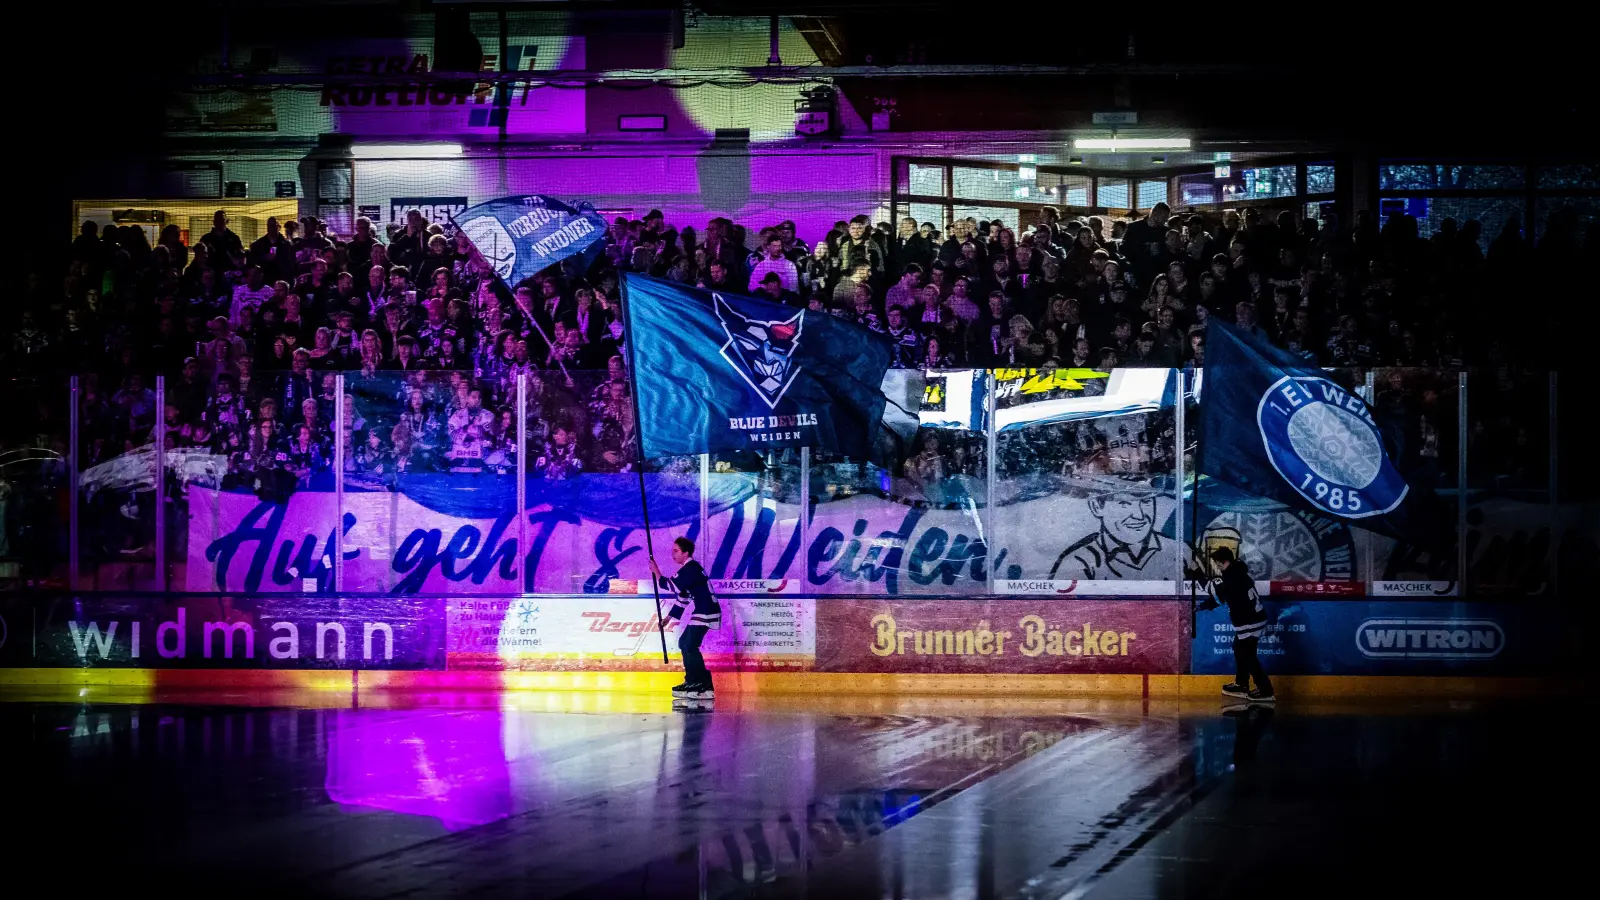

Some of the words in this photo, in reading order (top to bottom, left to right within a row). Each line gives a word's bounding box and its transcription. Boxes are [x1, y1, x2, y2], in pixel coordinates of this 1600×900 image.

[394, 205, 465, 226] KOSK
[531, 216, 595, 258] WEIDNER
[1321, 384, 1377, 426] WEI
[729, 417, 765, 430] BLUE
[769, 413, 818, 429] DEVILS
[750, 431, 801, 442] WEIDEN
[1299, 473, 1362, 511] 1985
[718, 581, 767, 591] MASCHEK
[1007, 581, 1055, 591] MASCHEK
[1383, 583, 1432, 593] MASCHEK
[68, 606, 394, 660] widmann
[870, 613, 1013, 657] Brunner
[1018, 614, 1137, 658] Bäcker
[1365, 629, 1495, 649] WITRON
